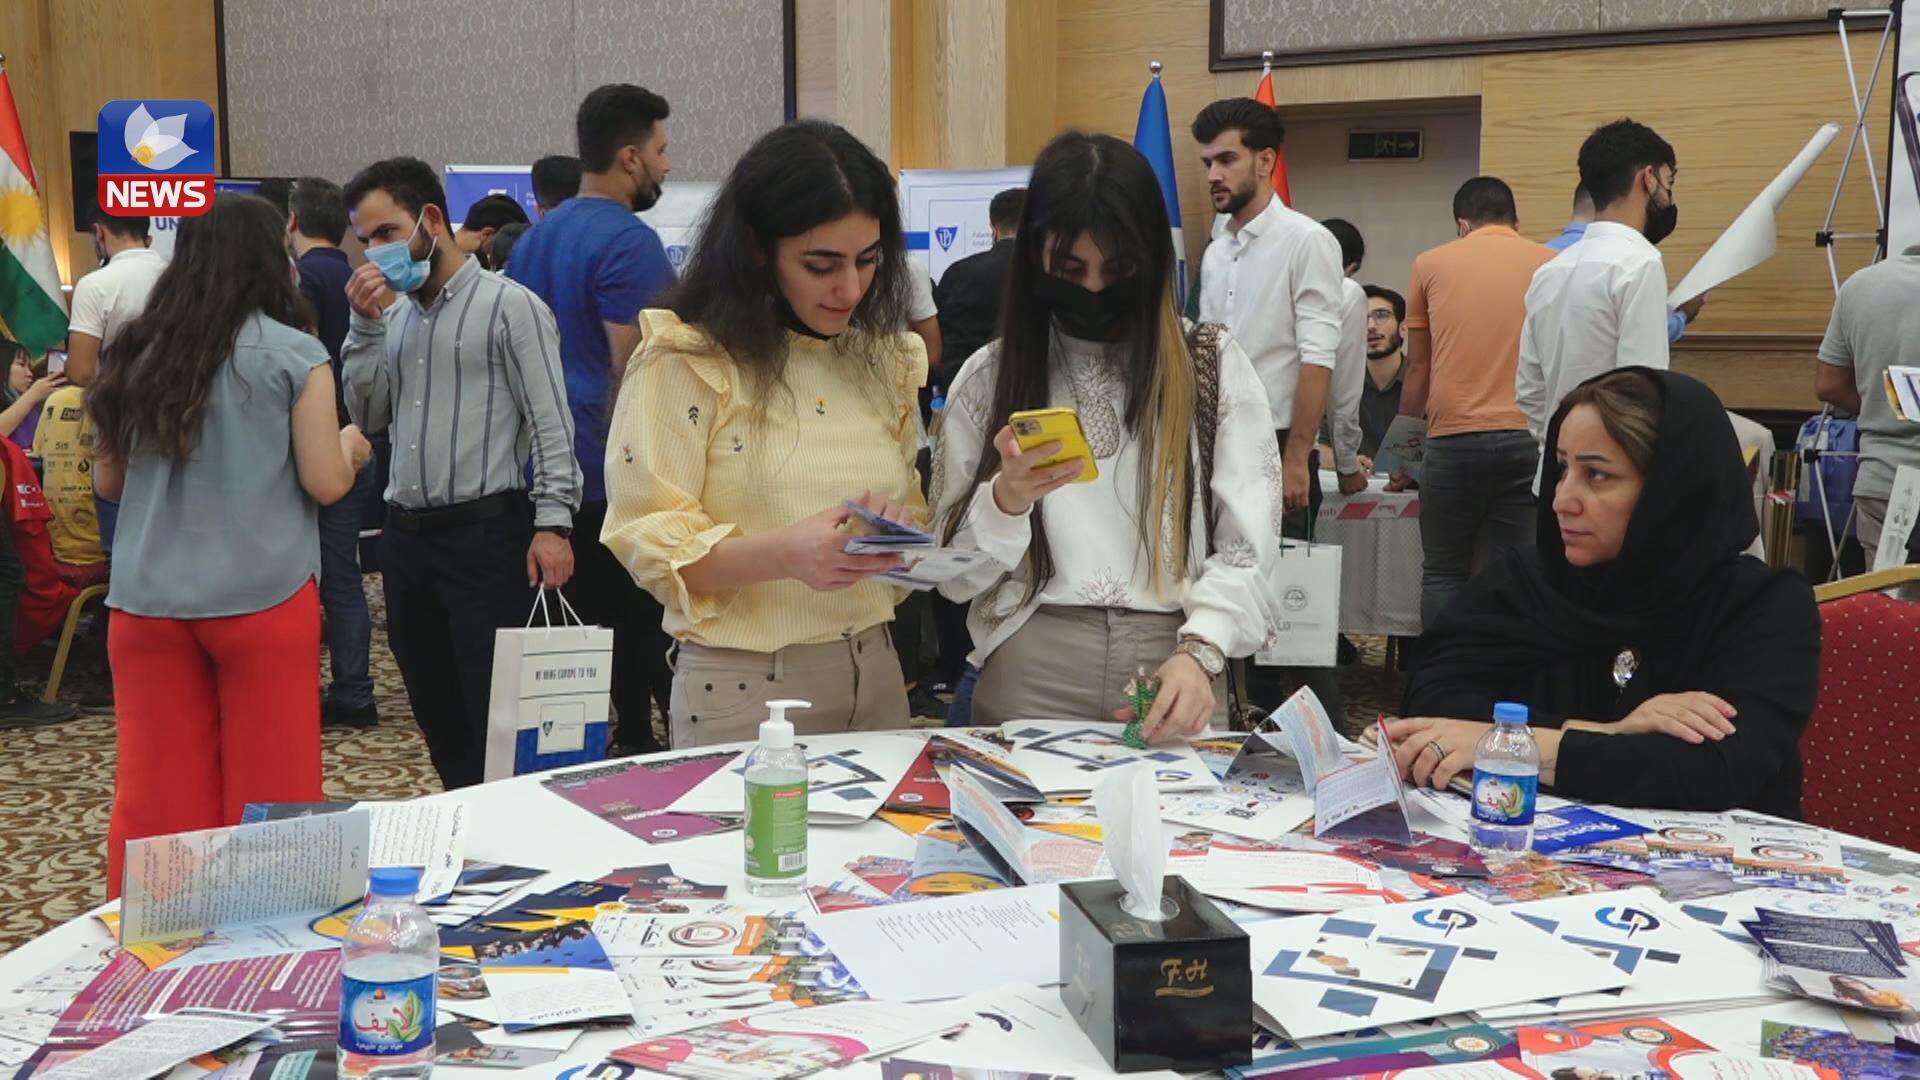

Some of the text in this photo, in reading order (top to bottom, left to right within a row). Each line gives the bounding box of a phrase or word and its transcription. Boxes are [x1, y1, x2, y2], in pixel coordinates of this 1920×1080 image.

[558, 668, 576, 681] EUROPE
[578, 667, 585, 679] TO
[586, 667, 597, 679] YOU
[353, 1006, 410, 1038] لايف
